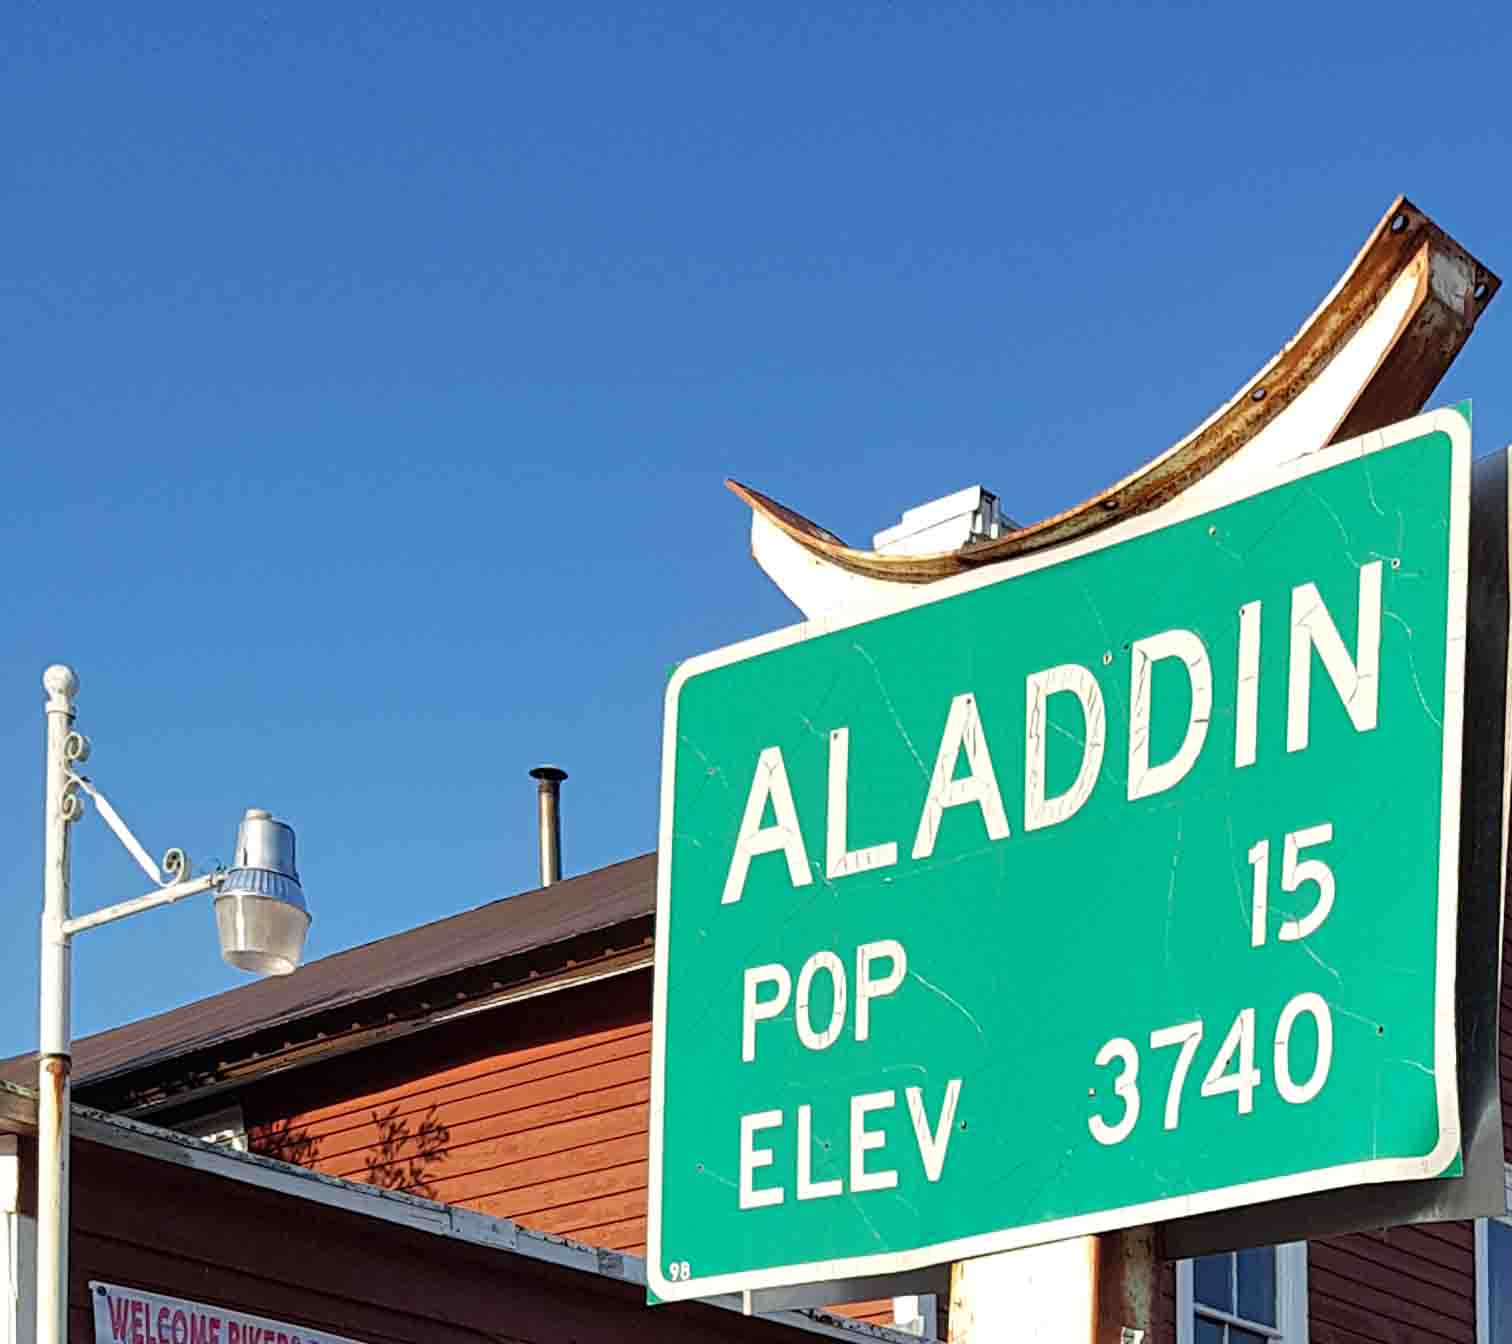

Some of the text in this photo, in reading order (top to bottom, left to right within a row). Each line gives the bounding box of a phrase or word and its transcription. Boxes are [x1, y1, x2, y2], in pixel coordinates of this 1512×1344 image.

[721, 561, 1382, 904] ALADDIN
[740, 823, 1336, 1063] POP 15
[739, 993, 1334, 1210] ELEV 3740
[669, 1261, 691, 1281] 98
